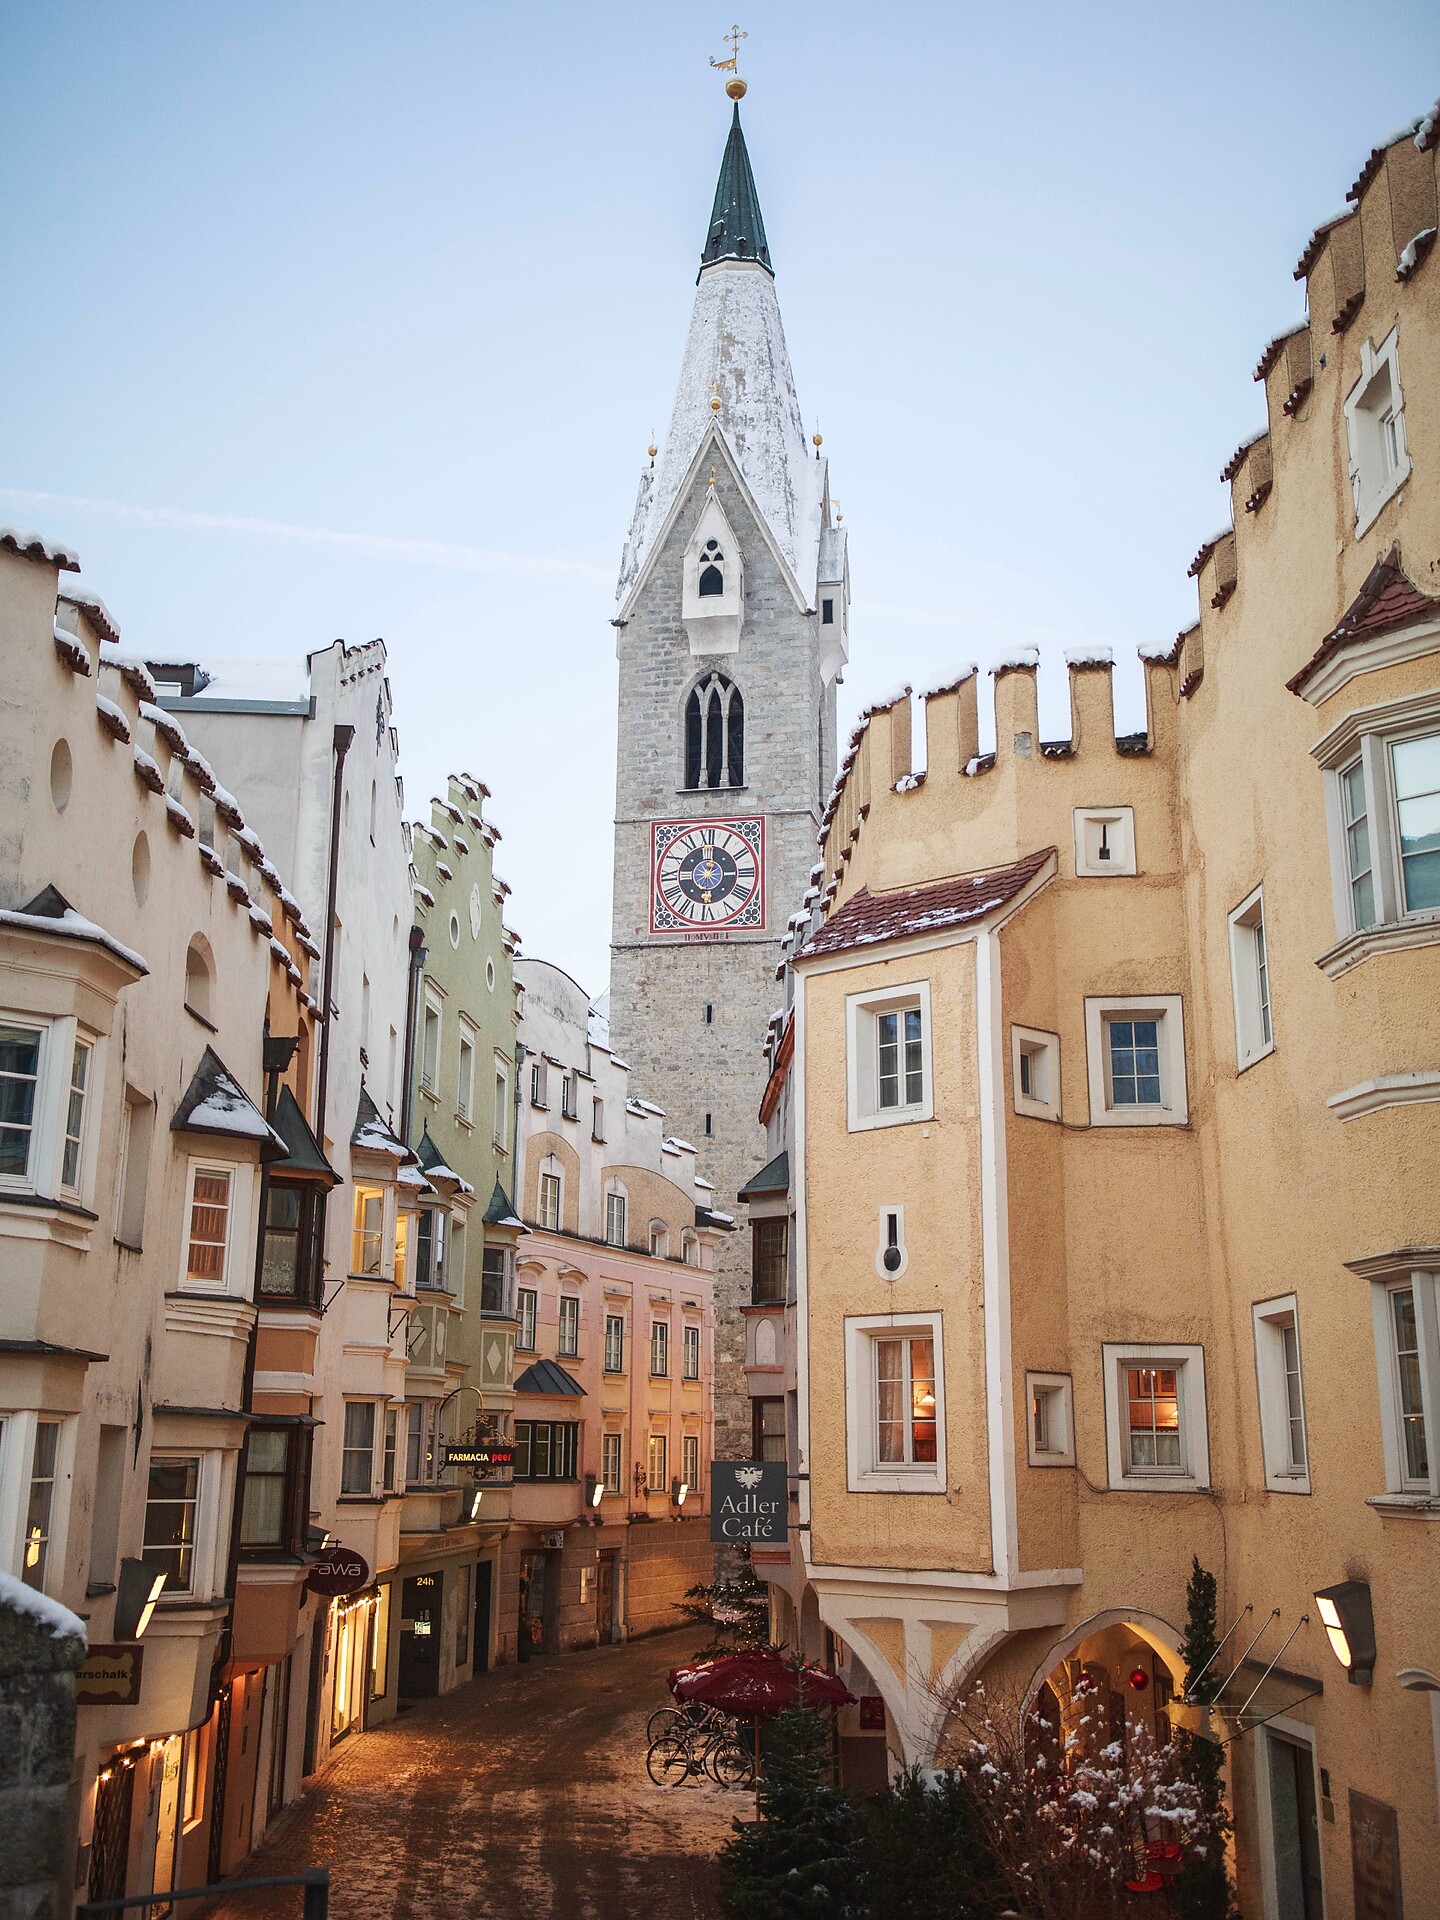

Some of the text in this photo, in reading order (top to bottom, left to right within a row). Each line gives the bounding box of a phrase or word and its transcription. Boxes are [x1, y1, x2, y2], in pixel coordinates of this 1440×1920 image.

[448, 1453, 512, 1463] FARMACIA peer
[719, 1493, 780, 1514] Adler
[721, 1516, 773, 1538] Café
[416, 1577, 434, 1586] 24h
[75, 1669, 129, 1680] arschalk
